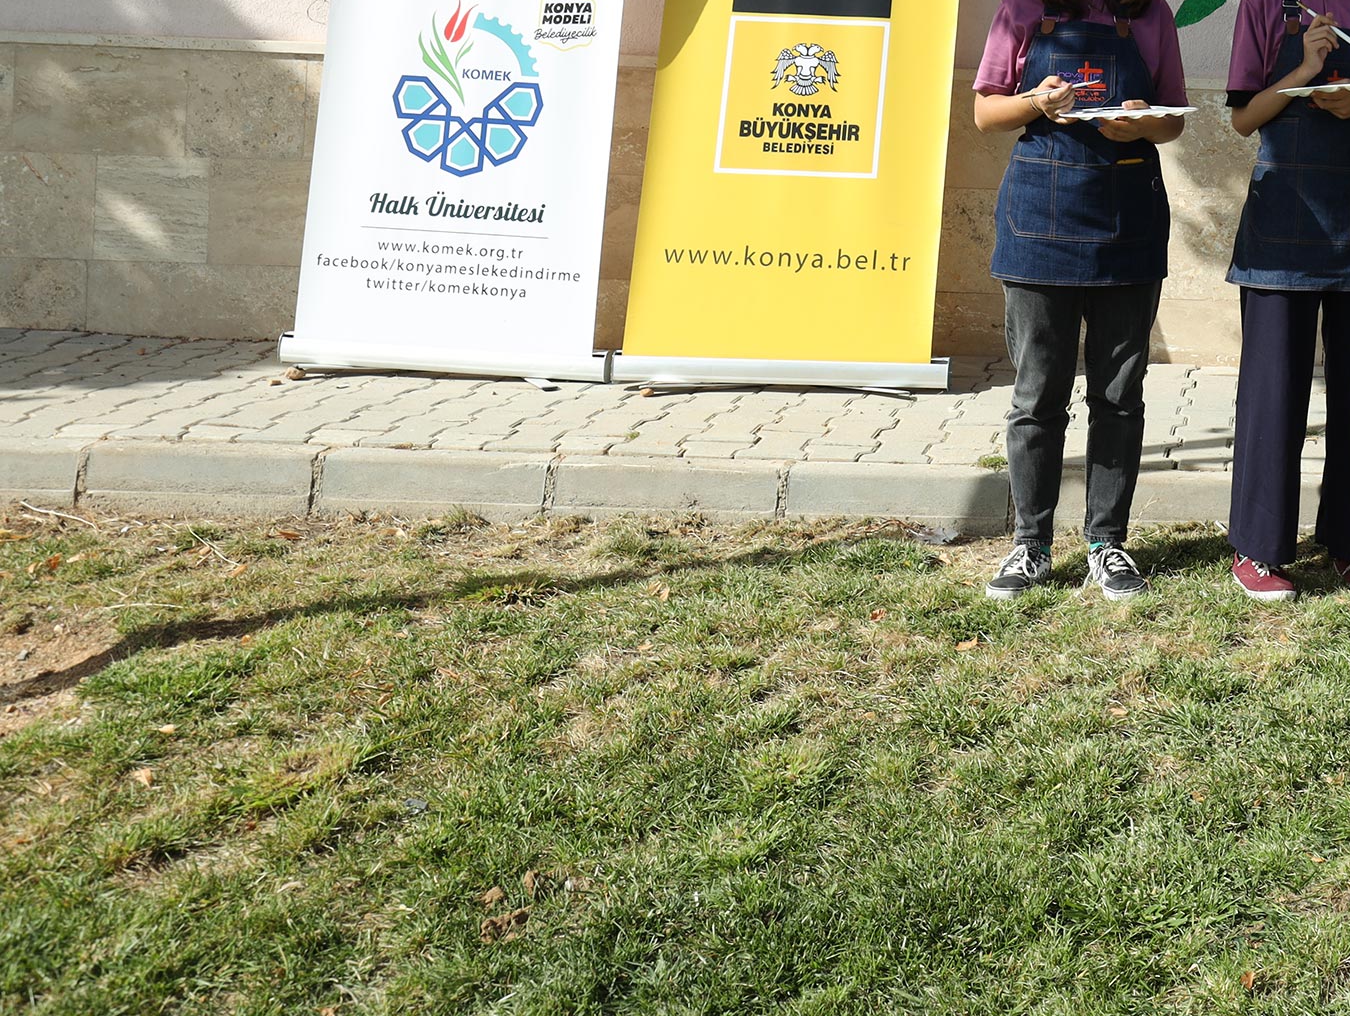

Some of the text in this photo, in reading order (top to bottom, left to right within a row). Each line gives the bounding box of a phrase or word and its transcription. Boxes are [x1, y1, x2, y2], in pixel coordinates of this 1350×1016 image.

[543, 2, 593, 14] KONYA
[533, 26, 598, 45] Belediyecilik
[462, 68, 512, 82] KOMEK
[772, 102, 832, 119] KONYA
[738, 116, 860, 142] BÜYÜKŞEHİR
[762, 142, 834, 155] BELEDİYESİ
[369, 190, 546, 224] Halk Üniversitesi
[377, 240, 524, 261] www.komek.org.tr
[664, 244, 911, 274] www.konya.bel.tr
[316, 253, 581, 283] facebook/konyameslekedindirme
[366, 277, 527, 299] twitter/komekkonya
